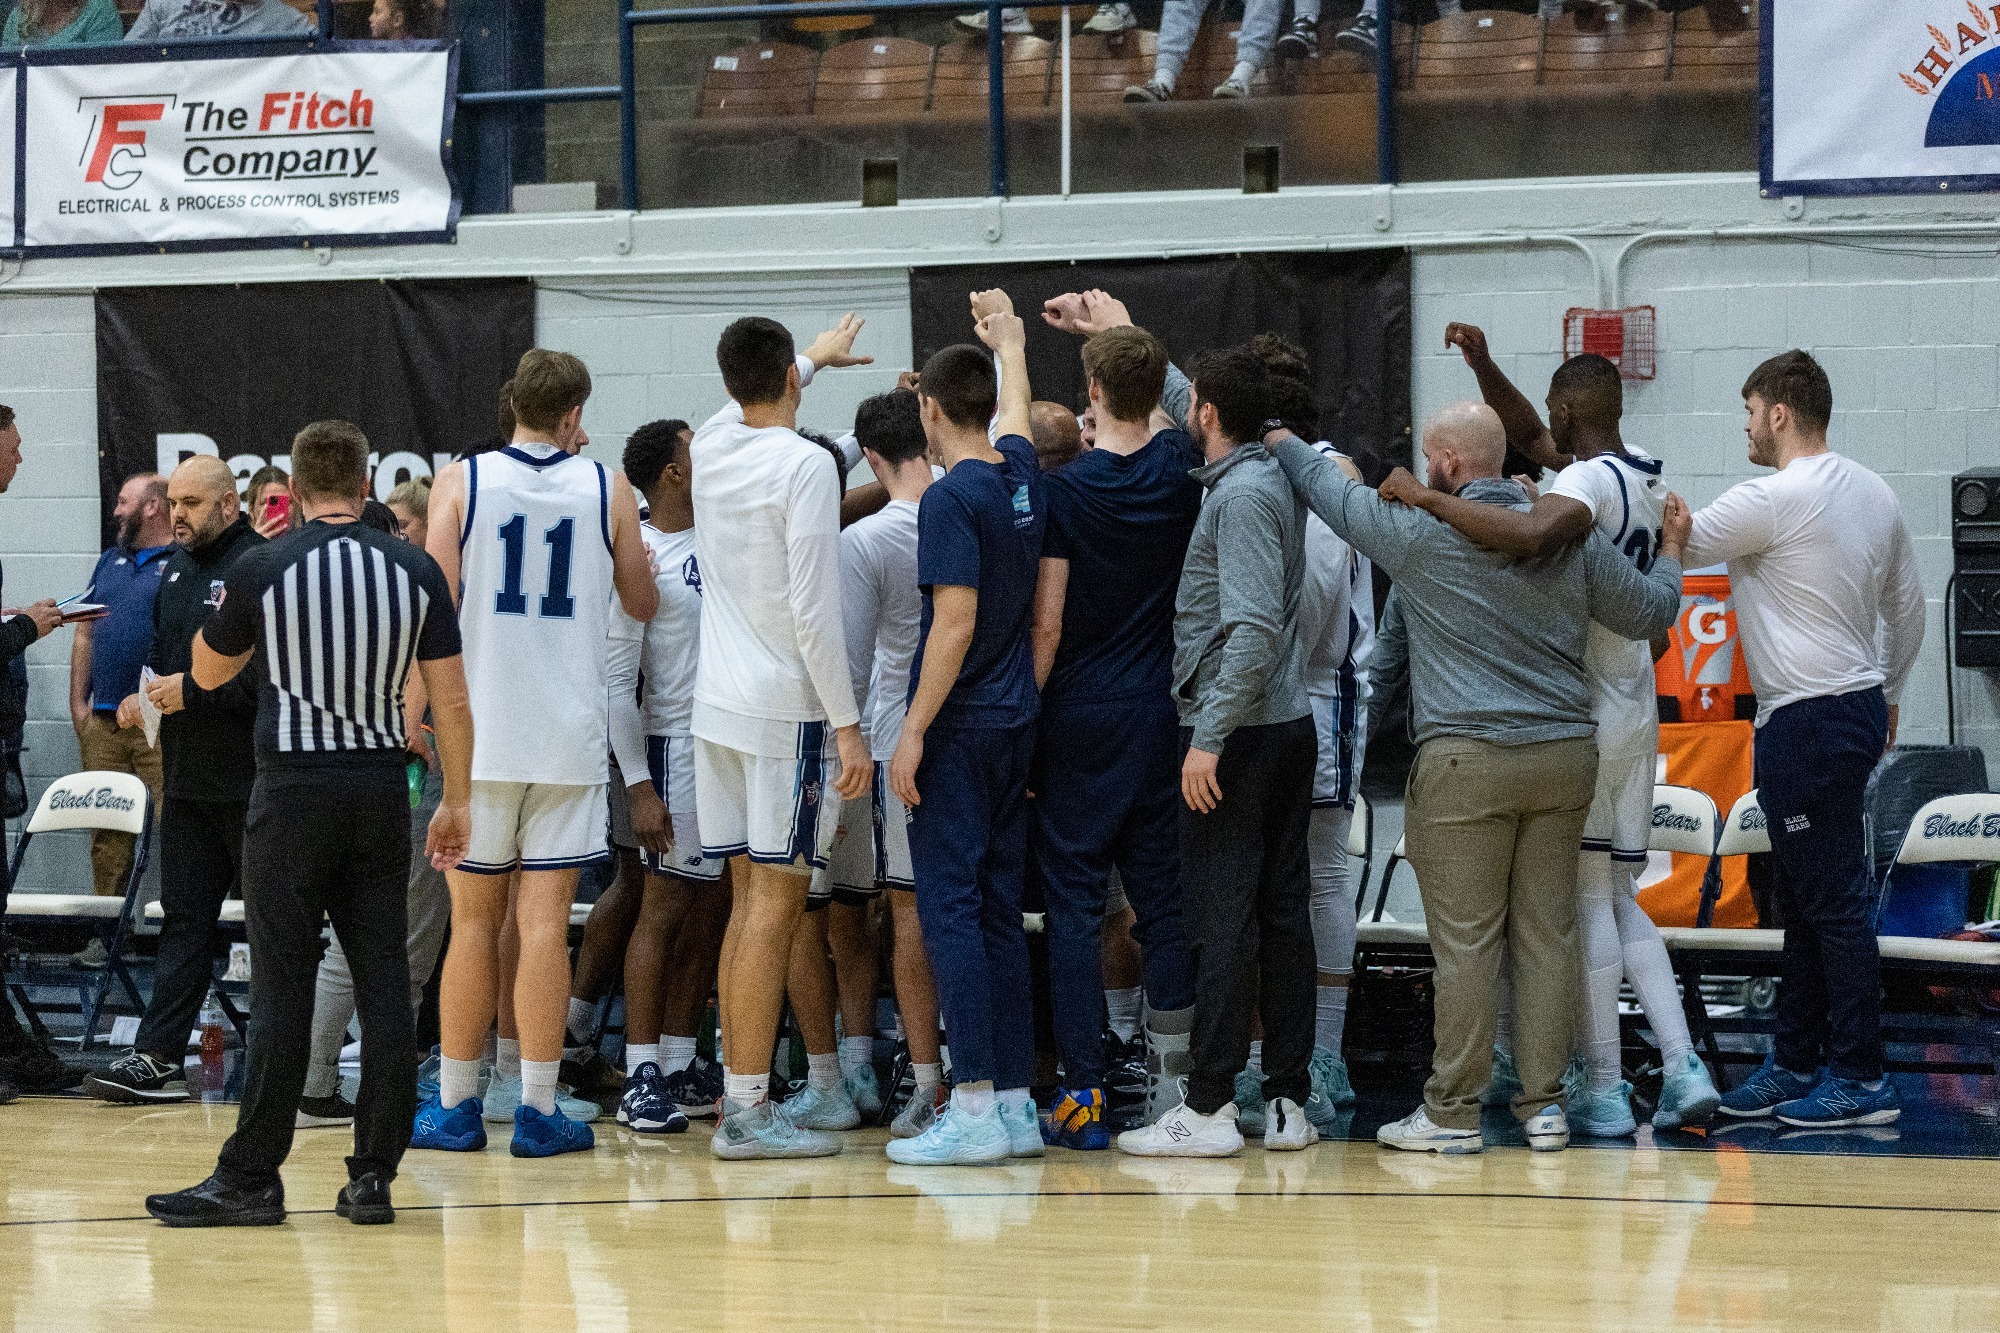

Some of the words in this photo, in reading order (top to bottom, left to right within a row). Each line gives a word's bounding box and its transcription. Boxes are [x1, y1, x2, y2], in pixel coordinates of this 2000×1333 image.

[182, 102, 248, 132] The
[259, 89, 373, 132] Fitch
[183, 146, 377, 181] Company
[59, 198, 151, 214] ELECTRICAL
[160, 197, 169, 212] &
[177, 195, 247, 209] PROCESS
[250, 193, 325, 208] CONTROL
[329, 190, 400, 206] SYSTEMS
[494, 513, 576, 619] 11
[1688, 602, 1727, 645] G
[49, 787, 95, 811] Black
[94, 786, 135, 812] Bears
[1651, 803, 1702, 832] Bears
[1784, 814, 1808, 825] BLACK
[1786, 820, 1810, 832] BEARS
[1922, 812, 1981, 839] Black
[1981, 812, 2000, 838] B
